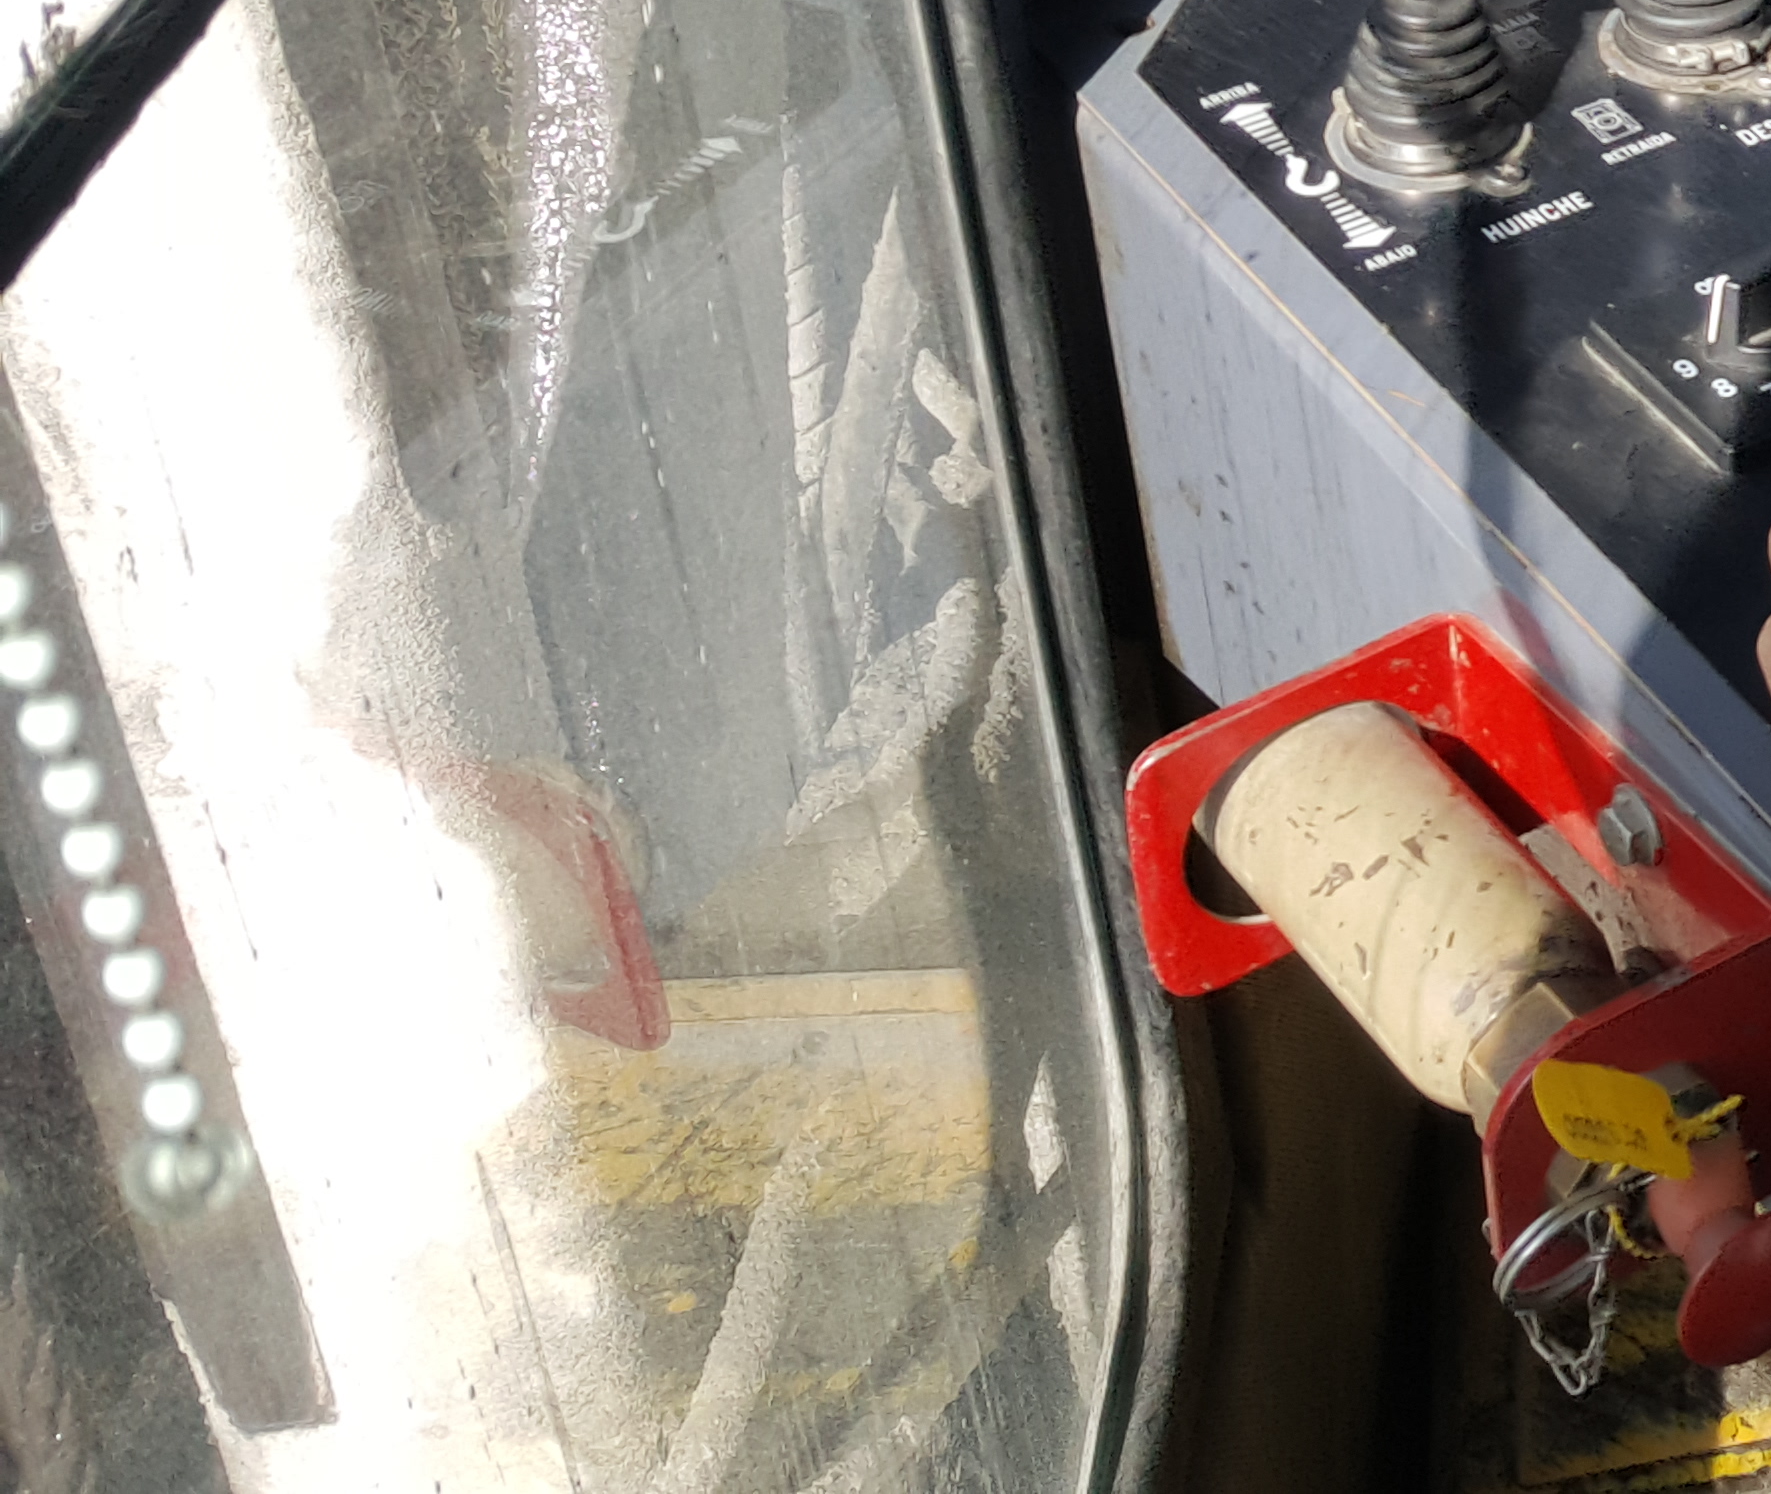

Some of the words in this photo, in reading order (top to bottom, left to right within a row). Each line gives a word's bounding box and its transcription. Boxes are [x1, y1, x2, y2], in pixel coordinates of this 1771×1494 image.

[1199, 82, 1261, 110] ARRIBA
[1601, 131, 1677, 166] RETRAIDA
[1480, 191, 1594, 244] HUINCHE
[1364, 244, 1418, 272] ABAJO
[1672, 359, 1700, 379] 9
[1711, 377, 1739, 398] 8
